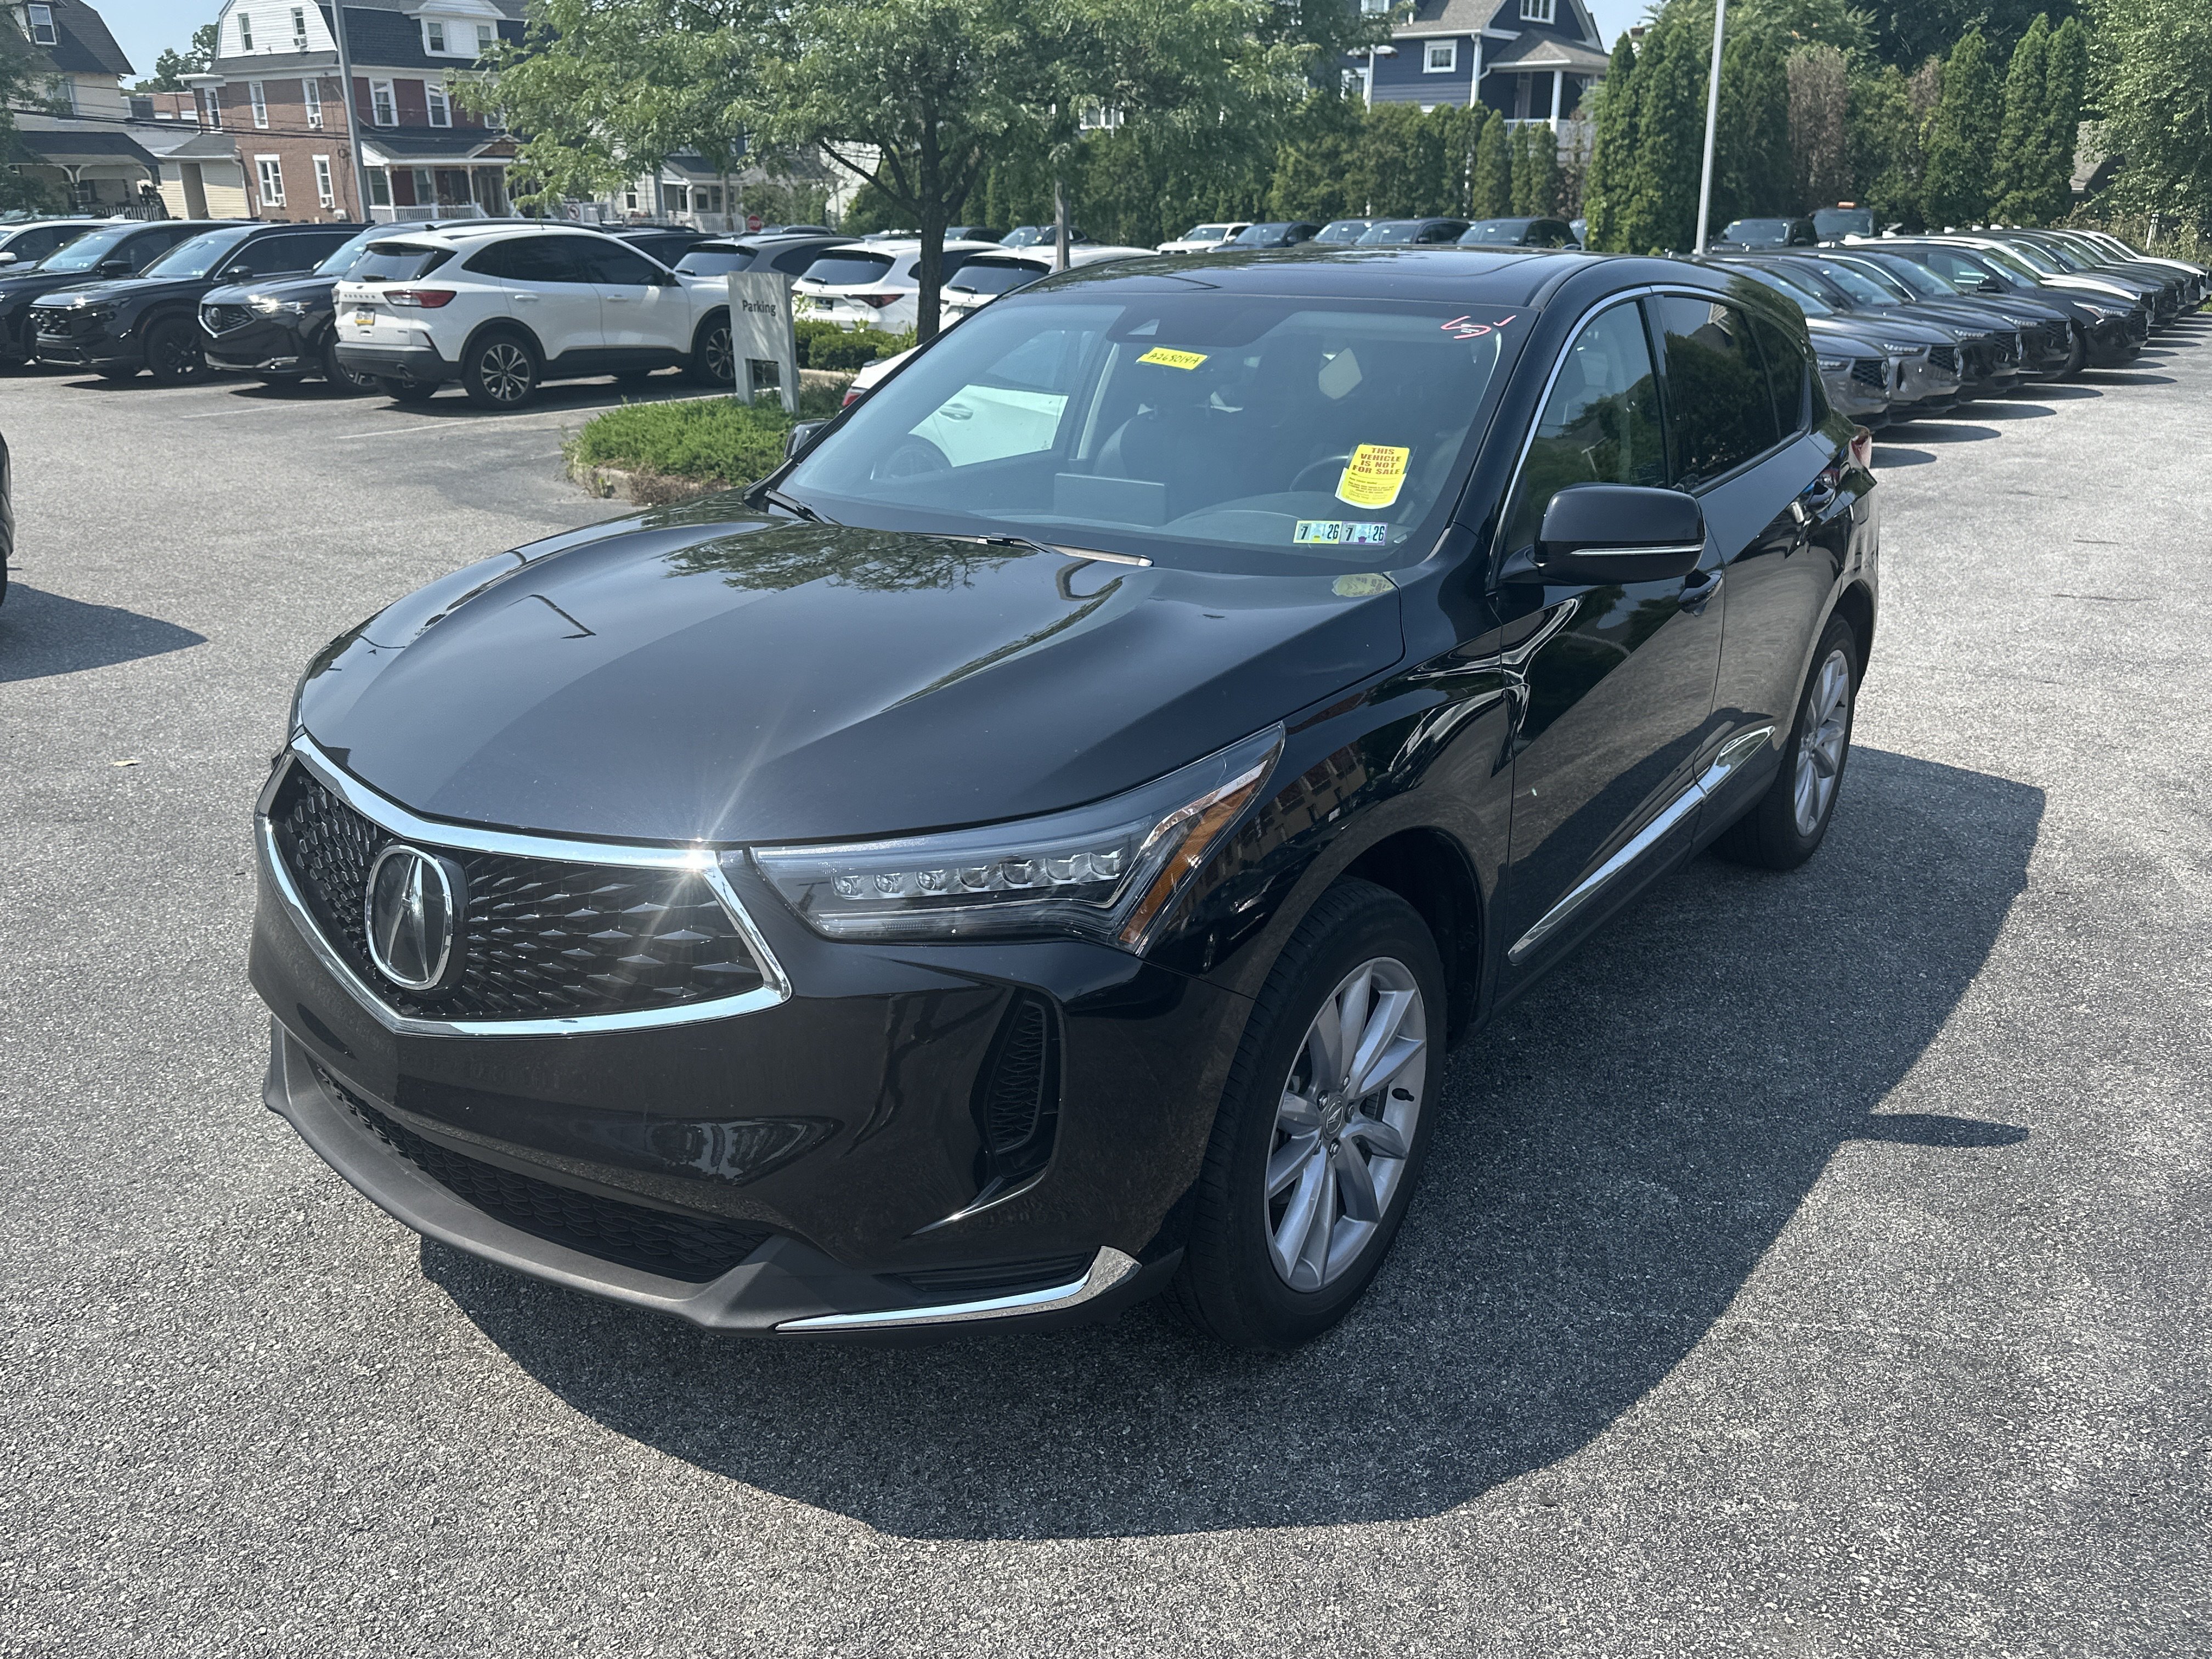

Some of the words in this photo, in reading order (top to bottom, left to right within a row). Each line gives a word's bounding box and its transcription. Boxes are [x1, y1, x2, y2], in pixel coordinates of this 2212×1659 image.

[742, 300, 776, 317] Parking
[1361, 453, 1402, 462] VEHICLE
[1352, 465, 1372, 473] FOR
[1301, 526, 1308, 540] 7
[1327, 524, 1340, 539] 26
[1346, 527, 1353, 541] 7
[1373, 526, 1385, 541] 26
[1237, 773, 1254, 787] ACURA
